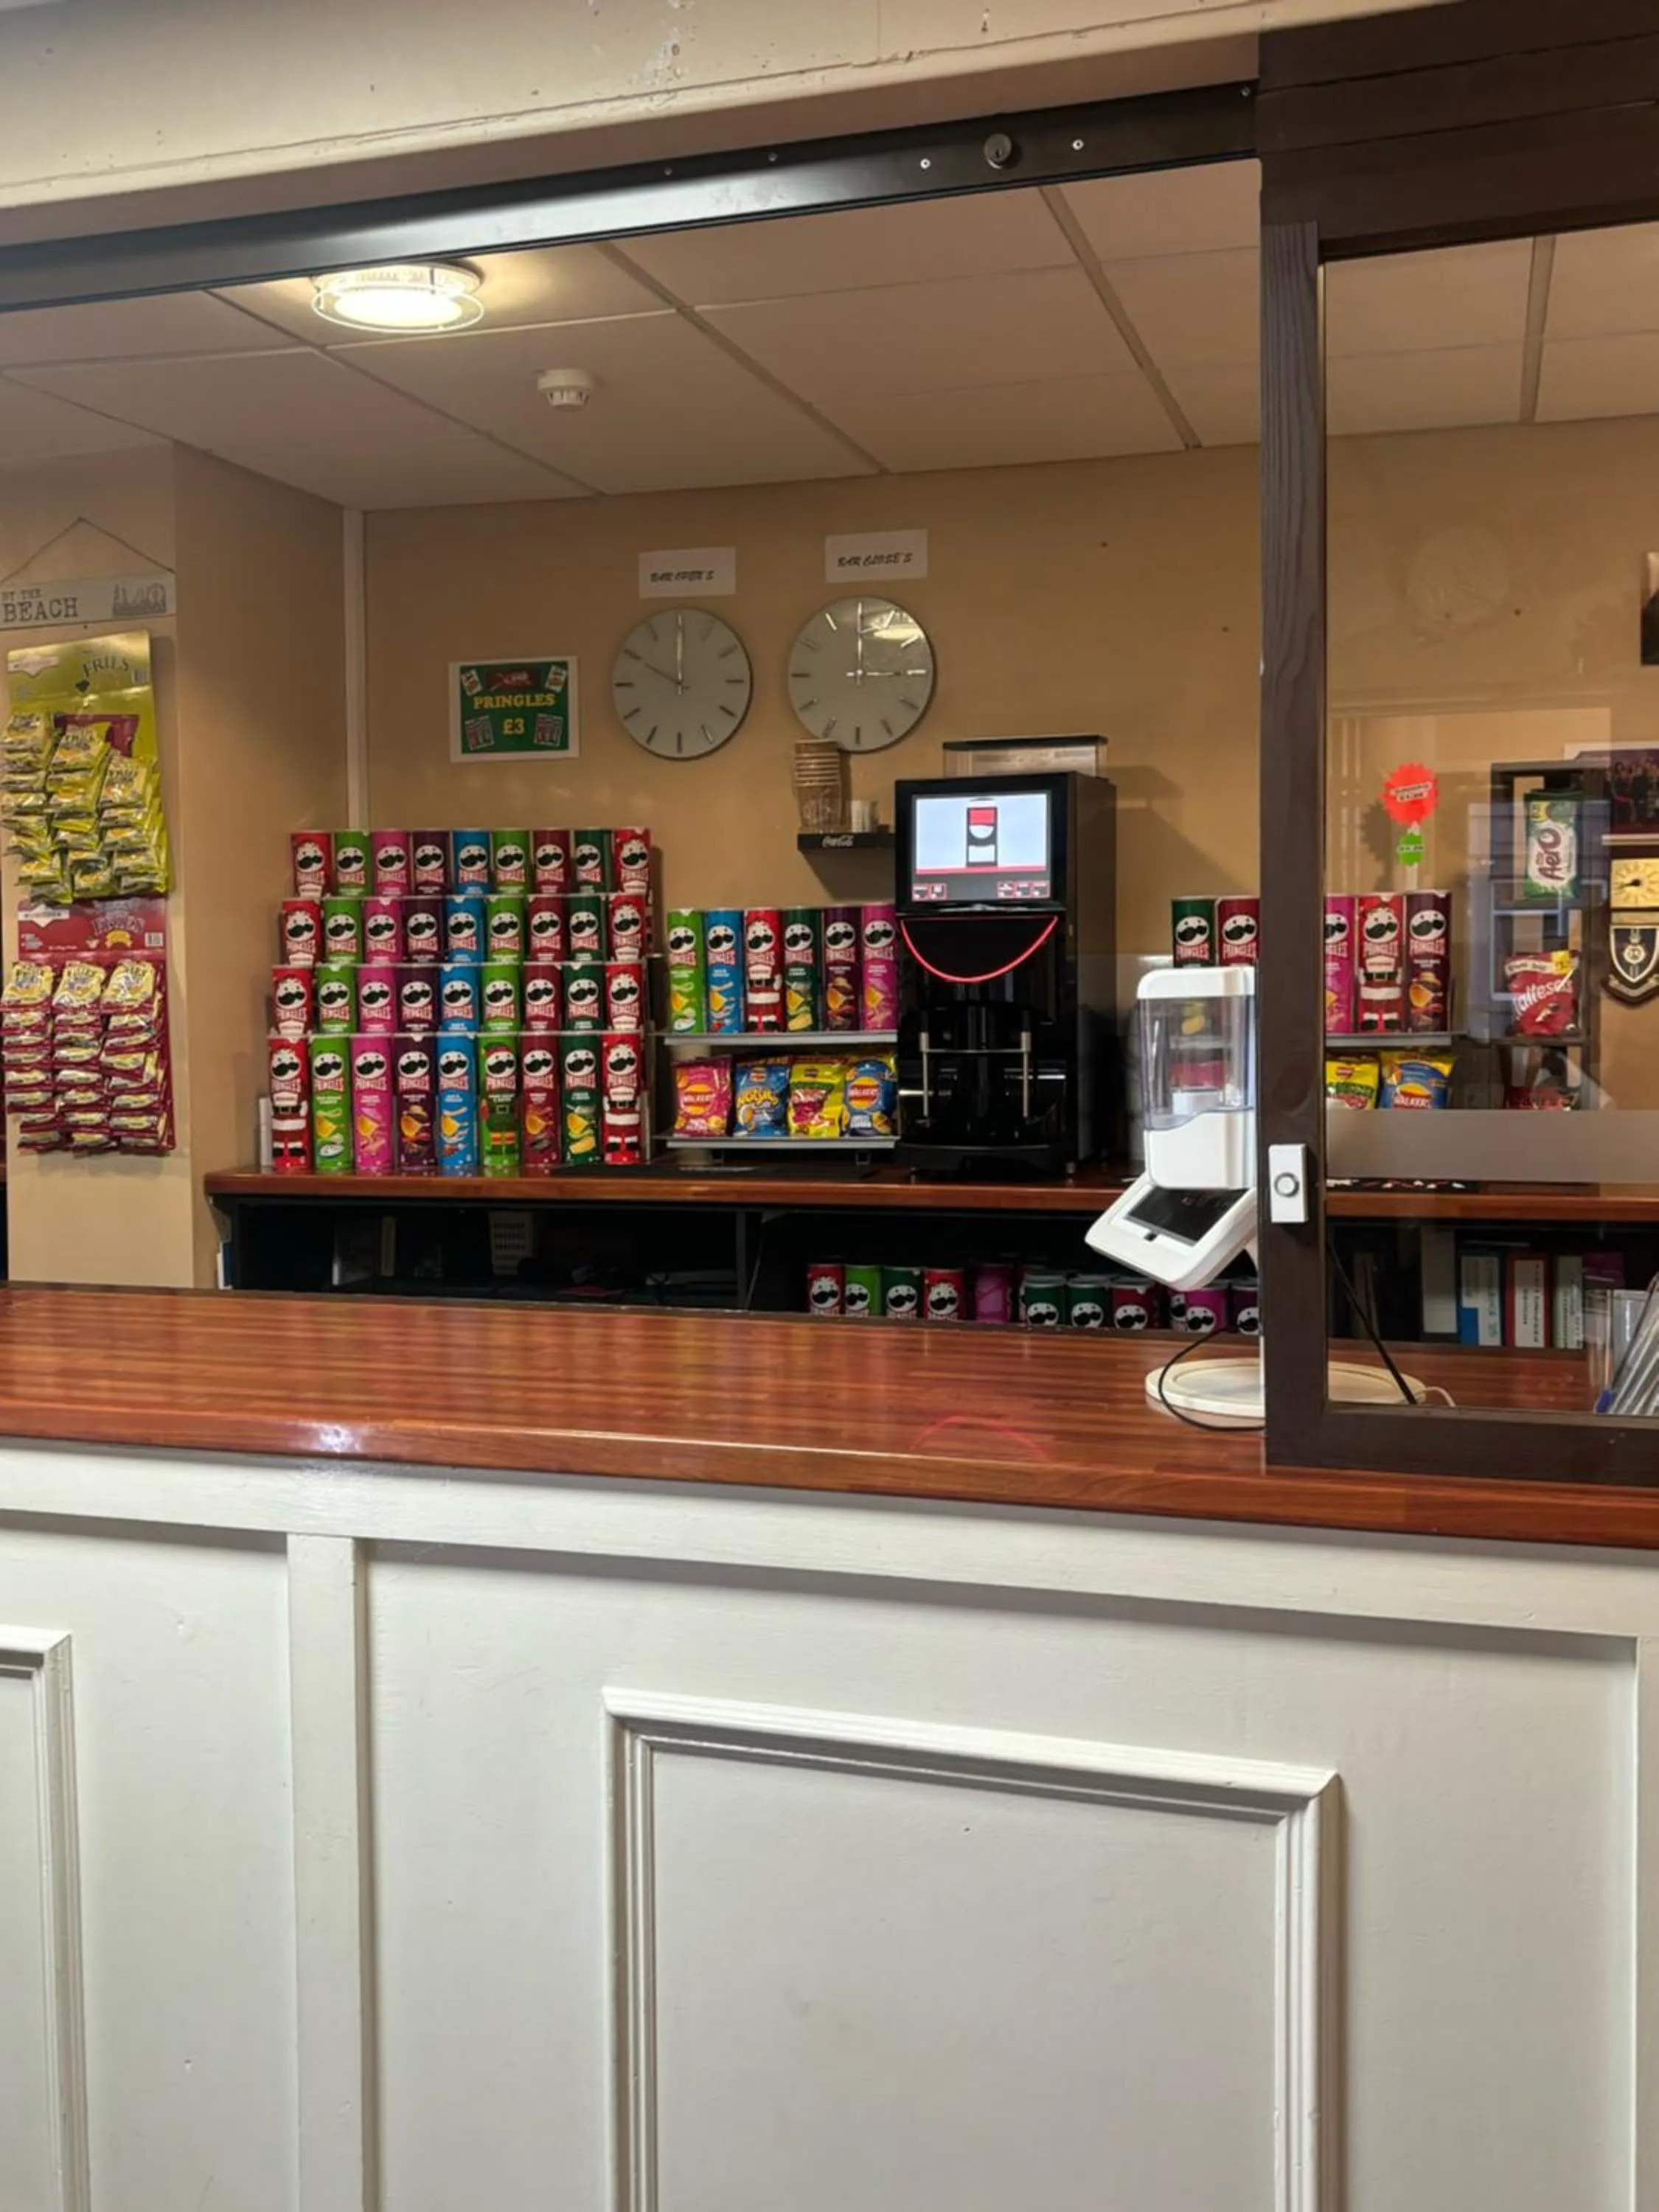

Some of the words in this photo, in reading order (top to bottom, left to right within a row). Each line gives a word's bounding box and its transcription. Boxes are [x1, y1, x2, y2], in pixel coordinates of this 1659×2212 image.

[3, 597, 79, 623] BEACH
[473, 692, 557, 710] PRINGLES
[502, 717, 526, 736] £3
